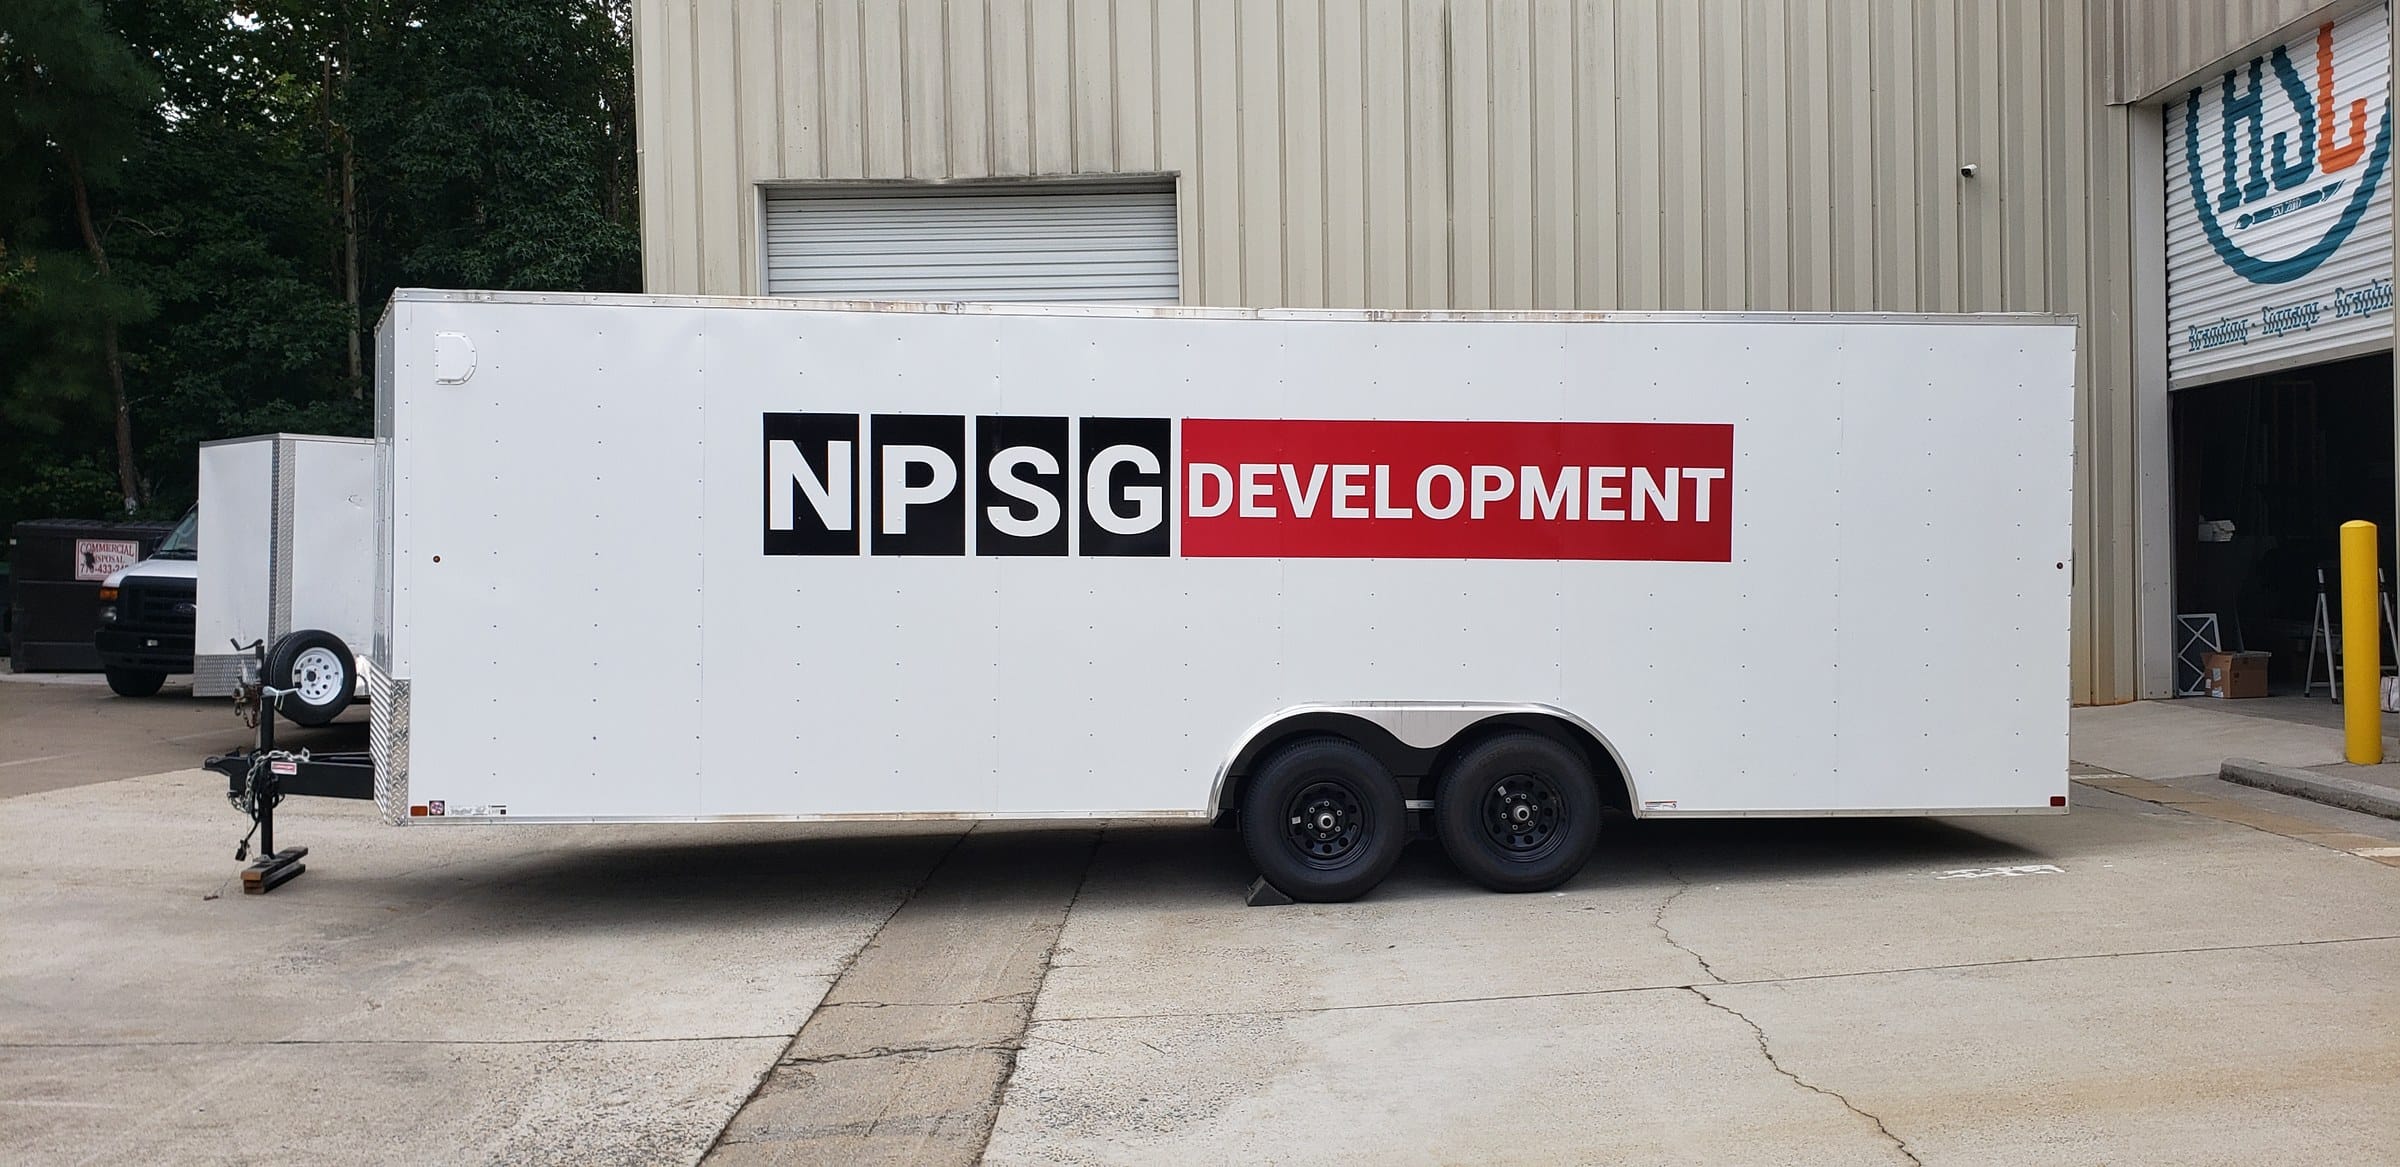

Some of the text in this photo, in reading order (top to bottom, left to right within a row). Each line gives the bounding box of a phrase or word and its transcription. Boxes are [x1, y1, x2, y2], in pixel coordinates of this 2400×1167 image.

[2188, 317, 2249, 352] Branding
[2262, 301, 2320, 337] Signage
[1188, 462, 1726, 523] DEVELOPMENT
[80, 543, 134, 557] COMMERCIAL
